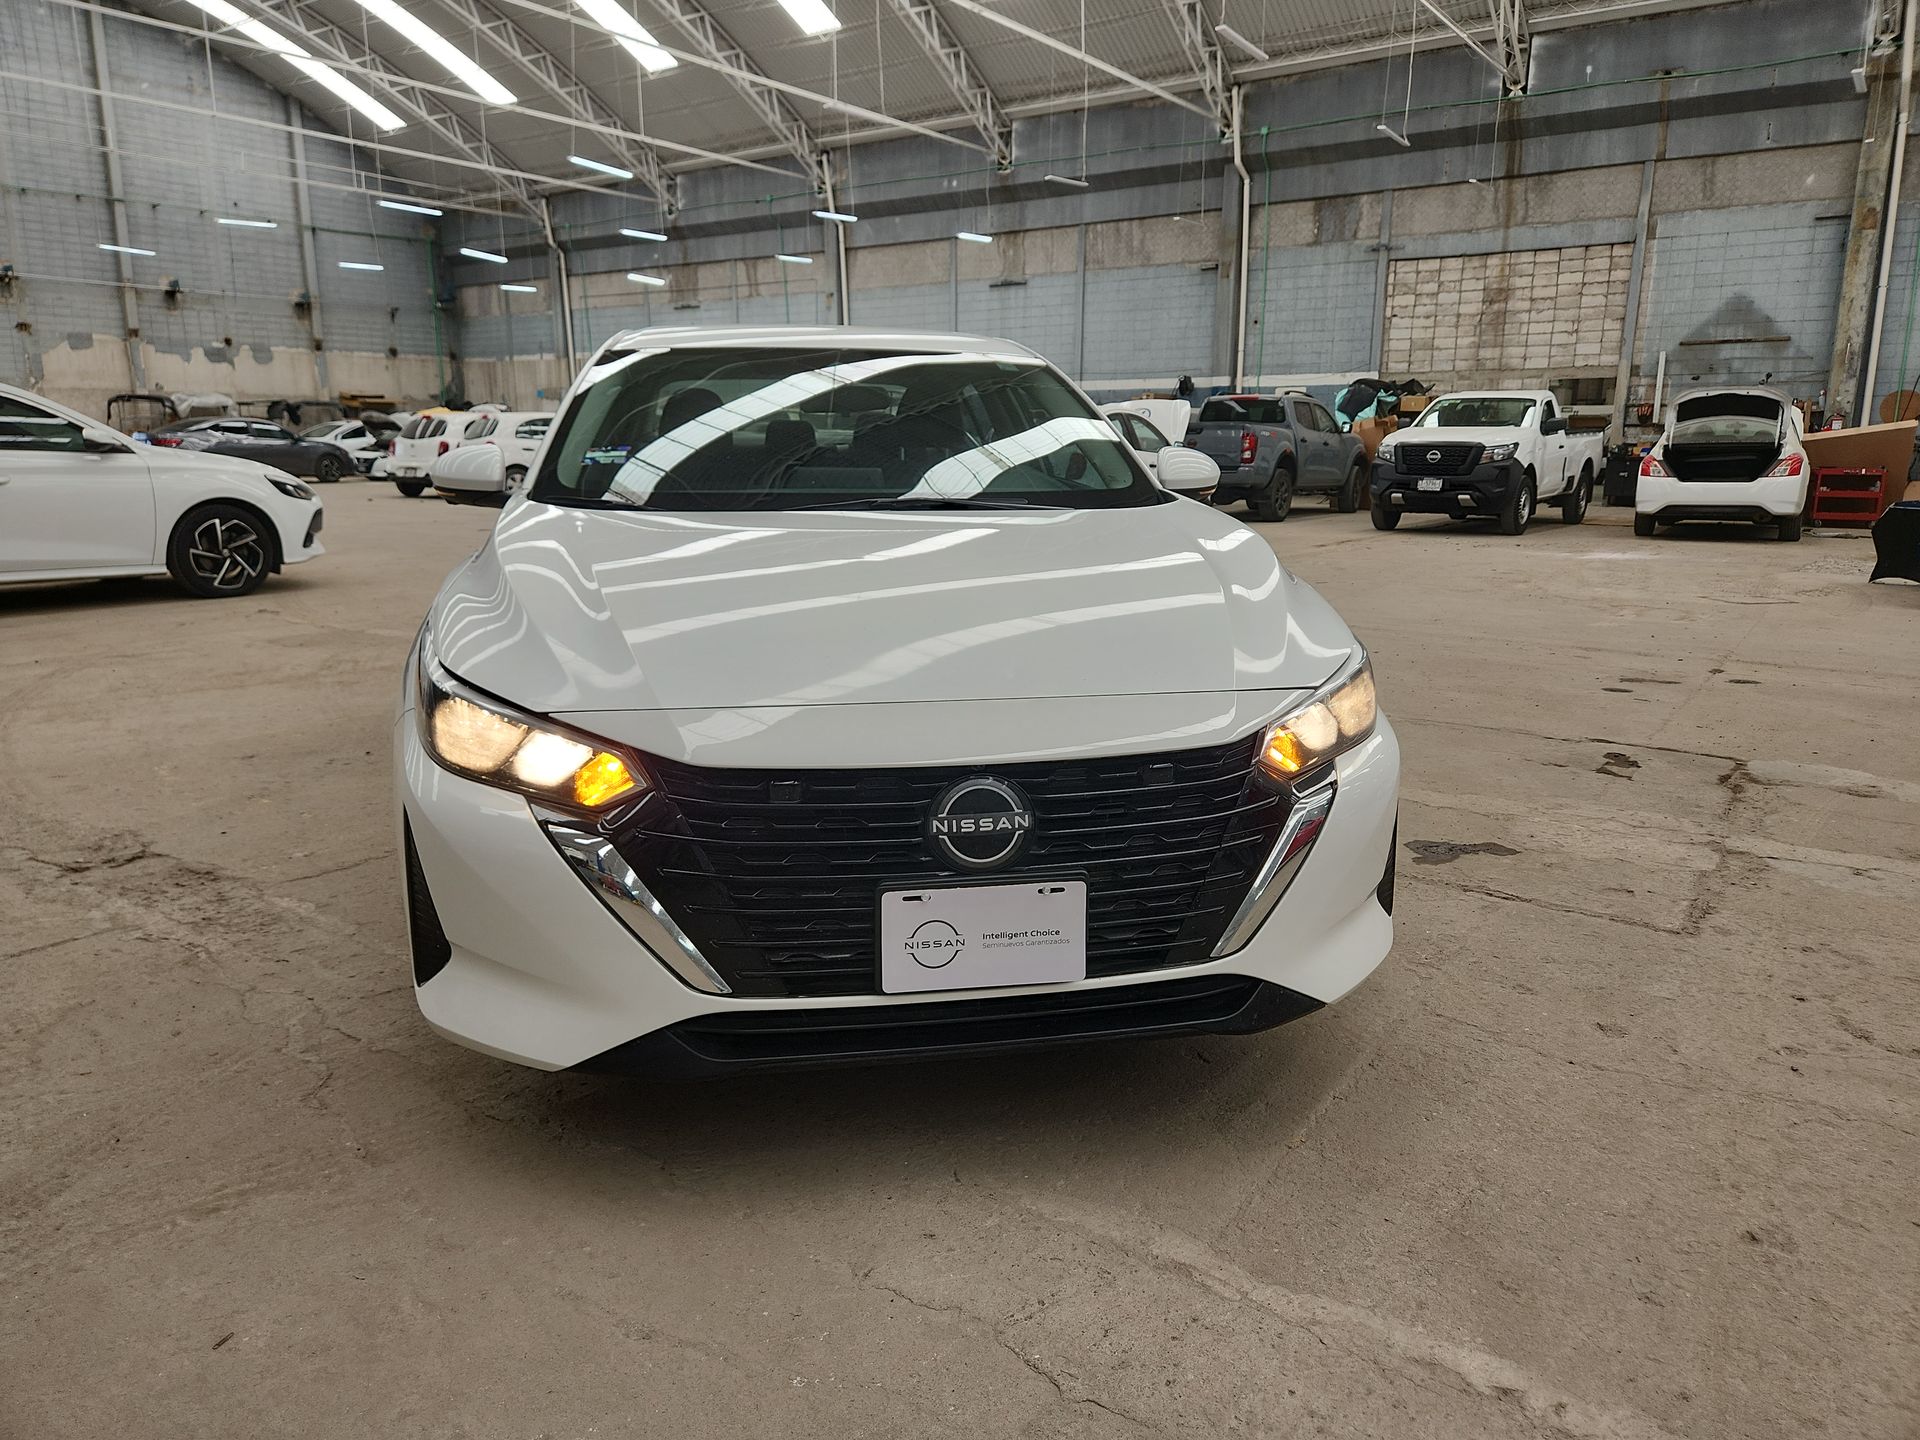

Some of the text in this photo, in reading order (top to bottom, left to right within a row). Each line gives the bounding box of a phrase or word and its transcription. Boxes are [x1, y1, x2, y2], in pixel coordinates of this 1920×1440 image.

[932, 814, 1029, 833] NISSAN
[982, 928, 1061, 940] Intelligent Choice
[904, 938, 966, 950] NISSAN
[982, 938, 1071, 949] Seminuevos Garantizados
